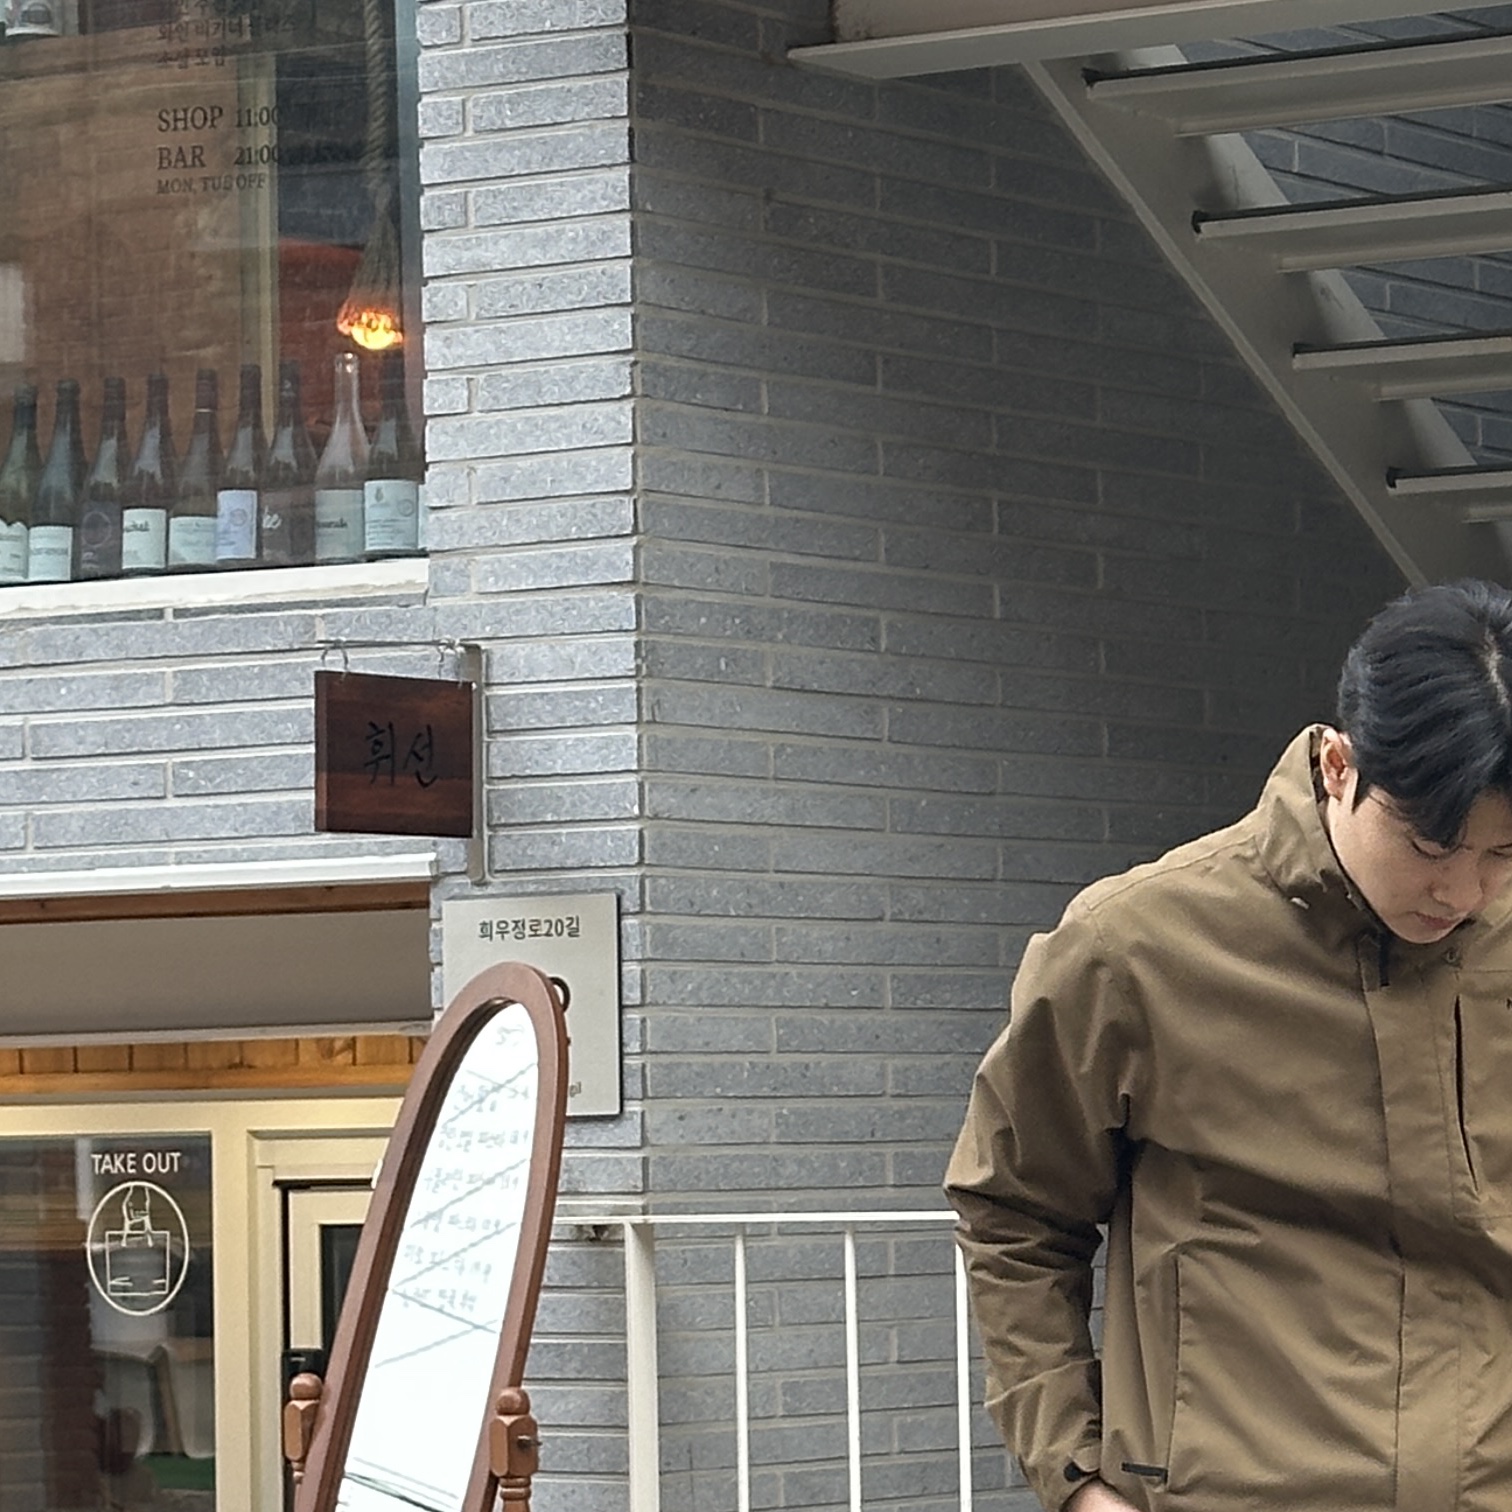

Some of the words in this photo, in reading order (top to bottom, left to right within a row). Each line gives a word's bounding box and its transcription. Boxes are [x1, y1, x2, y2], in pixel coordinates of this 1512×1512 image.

[158, 106, 223, 132] SHOP
[157, 144, 207, 170] BAR
[236, 173, 267, 190] OFF
[364, 721, 438, 788] 휘선
[478, 915, 581, 941] 희우정로20길
[91, 1153, 137, 1175] TAKE
[142, 1152, 182, 1173] OUT
